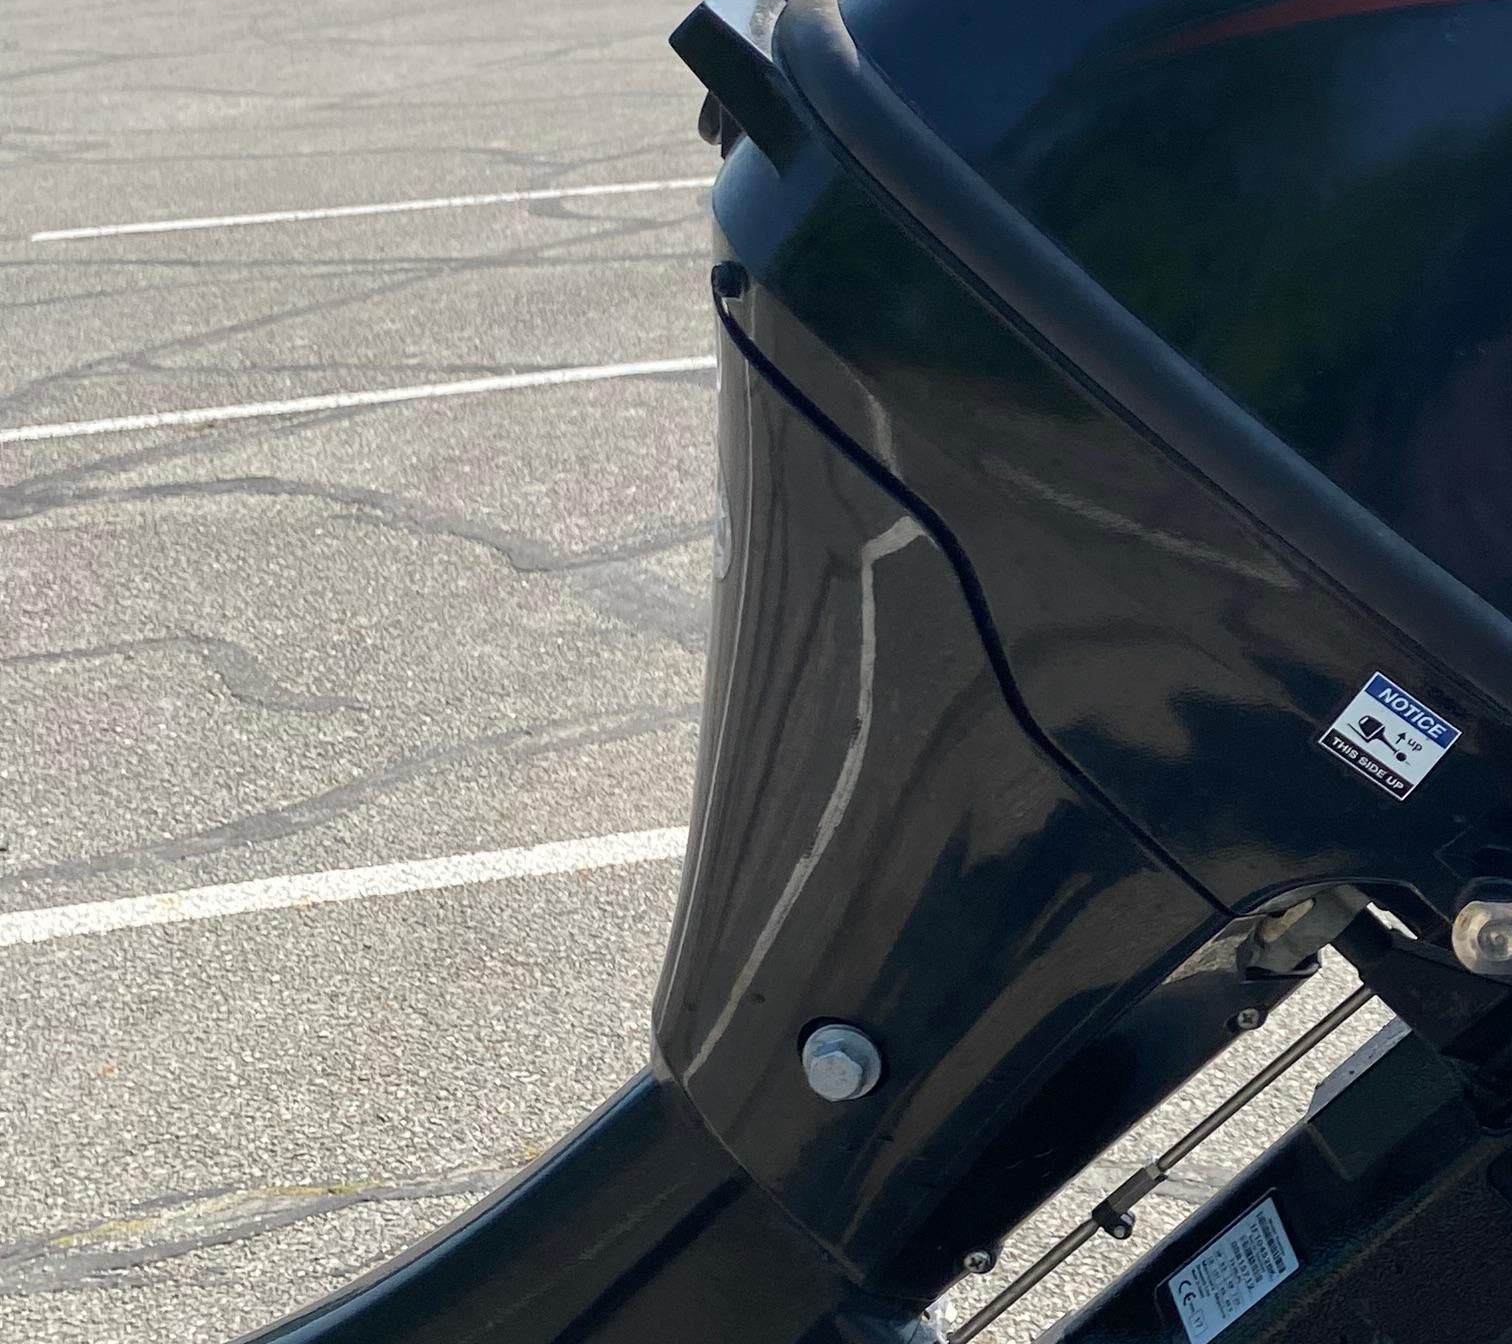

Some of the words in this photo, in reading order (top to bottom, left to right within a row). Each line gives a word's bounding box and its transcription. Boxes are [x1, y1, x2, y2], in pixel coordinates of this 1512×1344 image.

[1379, 688, 1447, 739] NOTICE
[1332, 736, 1359, 760] THIS
[1358, 757, 1387, 779] SIDE
[1386, 775, 1405, 790] UP
